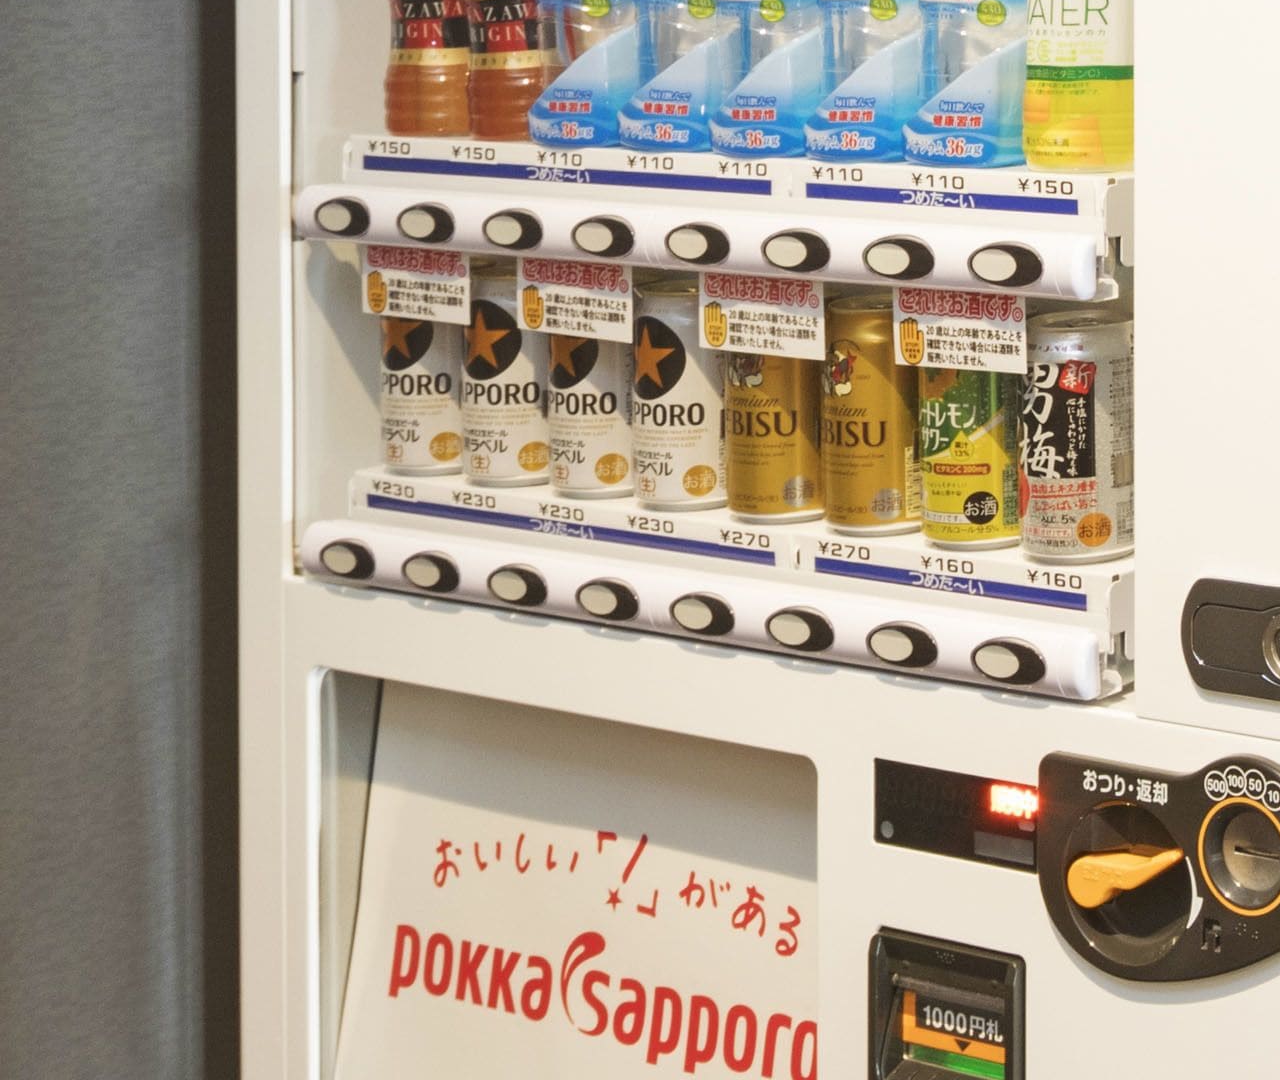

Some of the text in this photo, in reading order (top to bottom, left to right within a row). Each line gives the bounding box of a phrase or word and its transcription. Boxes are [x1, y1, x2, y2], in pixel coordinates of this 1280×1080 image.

[368, 140, 411, 155] ¥150
[451, 144, 496, 161] ¥150
[536, 150, 583, 167] ¥110
[626, 154, 675, 171] ¥110
[718, 160, 767, 177] ¥110
[812, 165, 864, 183] ¥110
[911, 172, 965, 190] ¥110
[1018, 177, 1074, 195] ¥150
[898, 287, 1024, 323] これはお酒です。
[1062, 363, 1092, 390] 新
[372, 480, 415, 498] ¥230
[452, 491, 497, 509] ¥230
[964, 496, 998, 517] お酒
[538, 504, 585, 521] ¥230
[627, 515, 674, 534] ¥230
[719, 529, 771, 548] ¥270
[817, 541, 871, 561] ¥270
[920, 556, 975, 575] ¥160
[1026, 569, 1083, 589] ¥160
[1082, 769, 1169, 806] おつり・返却
[1207, 774, 1280, 804] 500 100 50 10
[922, 1004, 1004, 1043] 1000円札
